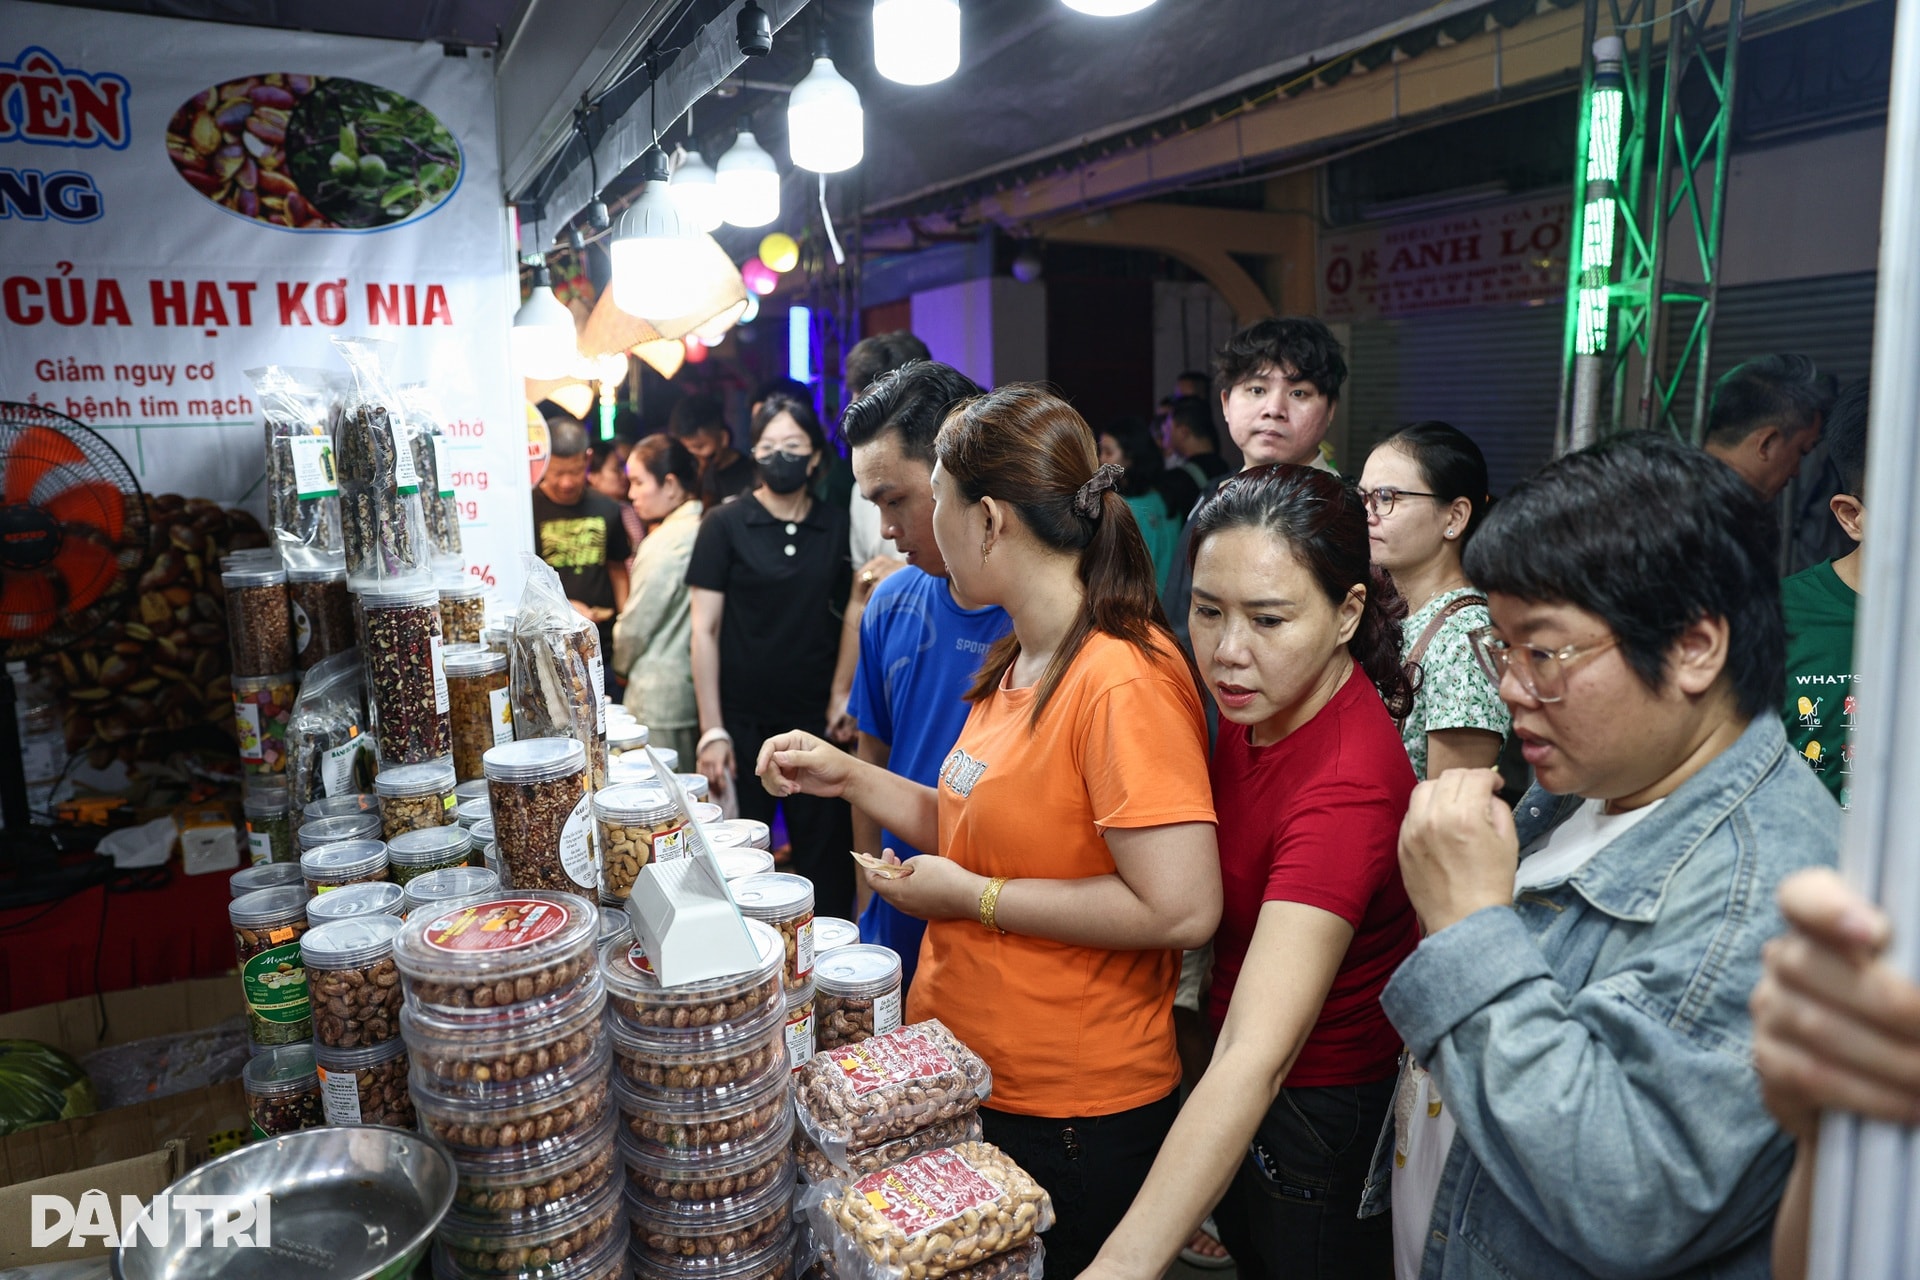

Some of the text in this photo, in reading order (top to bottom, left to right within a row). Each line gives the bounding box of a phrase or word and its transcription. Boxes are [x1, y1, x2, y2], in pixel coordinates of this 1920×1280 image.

[1389, 218, 1565, 273] ANH LỢ
[2, 260, 454, 337] CỦA HẠT KƠ NIA
[35, 356, 216, 387] Giảm nguy cơ
[65, 395, 131, 423] bệnh
[140, 396, 179, 416] tim
[188, 395, 253, 420] mạch
[1795, 674, 1863, 685] WHAT'S
[260, 951, 296, 965] Mixed
